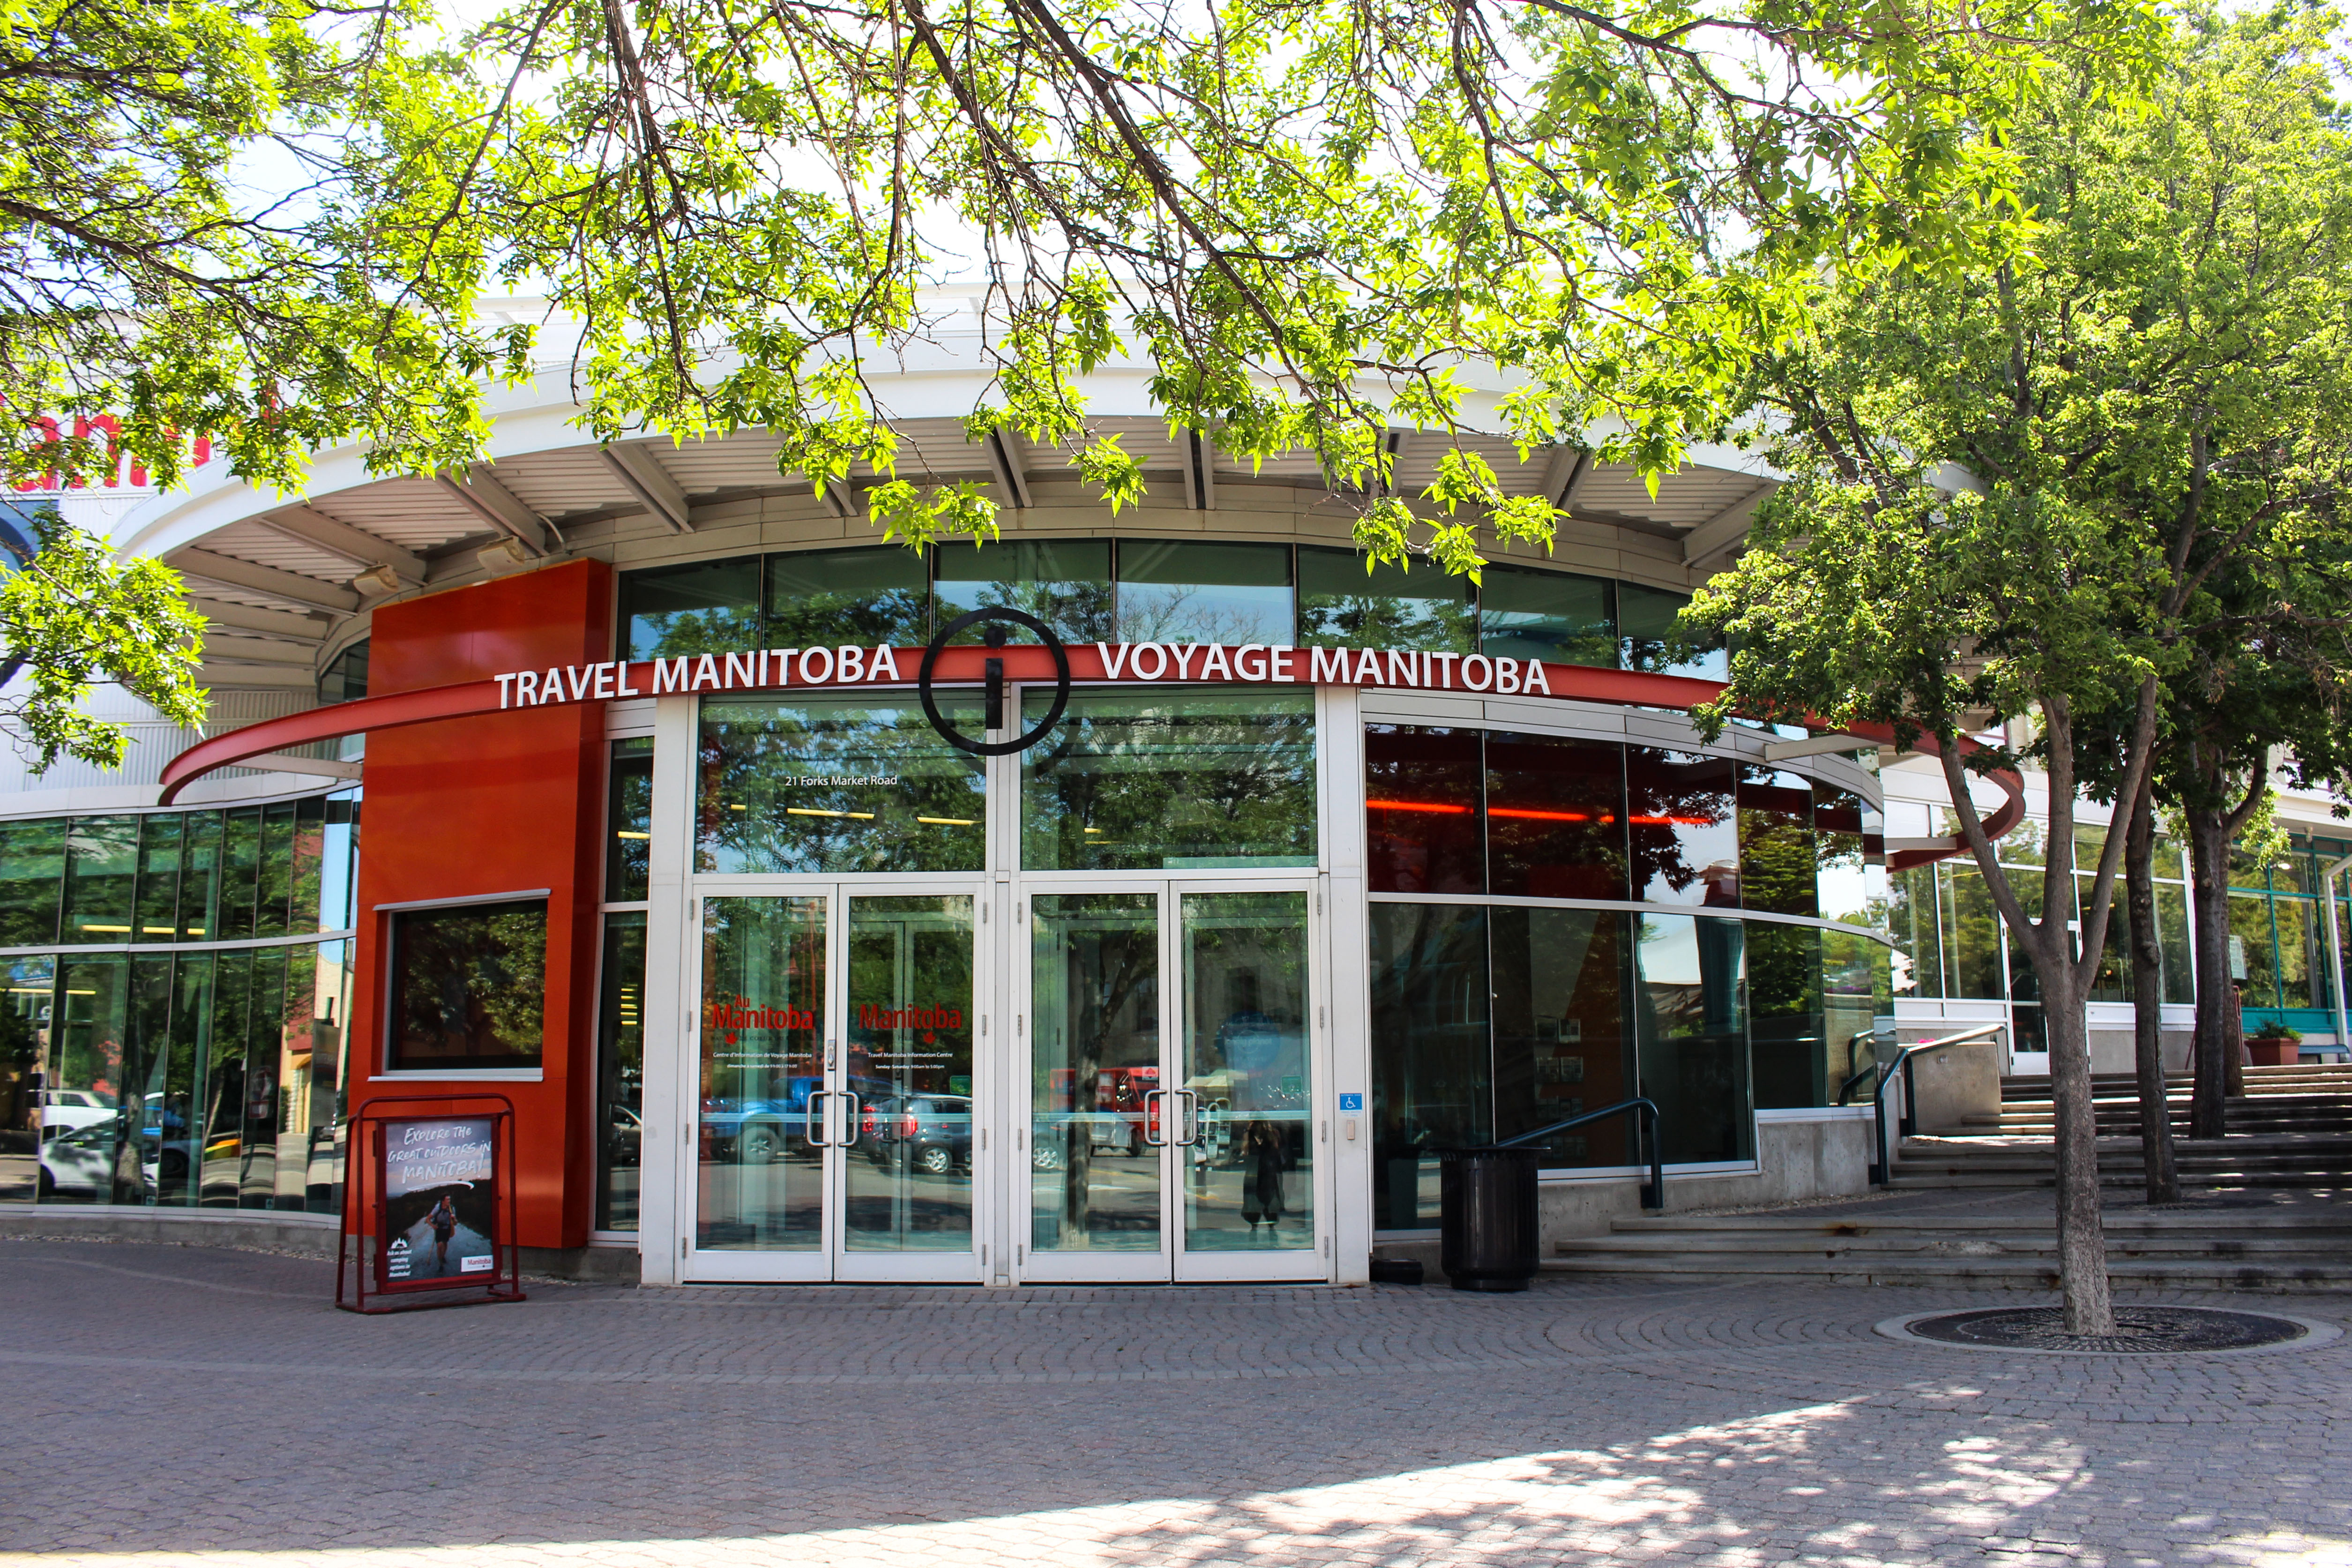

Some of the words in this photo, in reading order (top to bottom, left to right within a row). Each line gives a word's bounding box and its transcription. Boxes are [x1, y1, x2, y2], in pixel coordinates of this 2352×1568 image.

[494, 661, 638, 709] TRAVEL
[652, 643, 900, 694] MANITOBA
[1097, 642, 1295, 682] VOYAGE
[1310, 645, 1551, 695] MANITOBA
[785, 777, 797, 786] 21
[801, 776, 828, 786] Forks
[831, 776, 867, 785] Market
[871, 775, 897, 785] Road
[734, 994, 750, 1008] Au
[712, 1003, 814, 1030] Manitoba
[859, 1003, 962, 1029] Manitoba
[404, 1128, 450, 1145] EXPLORE
[454, 1127, 472, 1138] THE
[388, 1148, 424, 1162] GREAT
[424, 1142, 476, 1158] OUTDOORS
[403, 1153, 484, 1184] MANITOBA!
